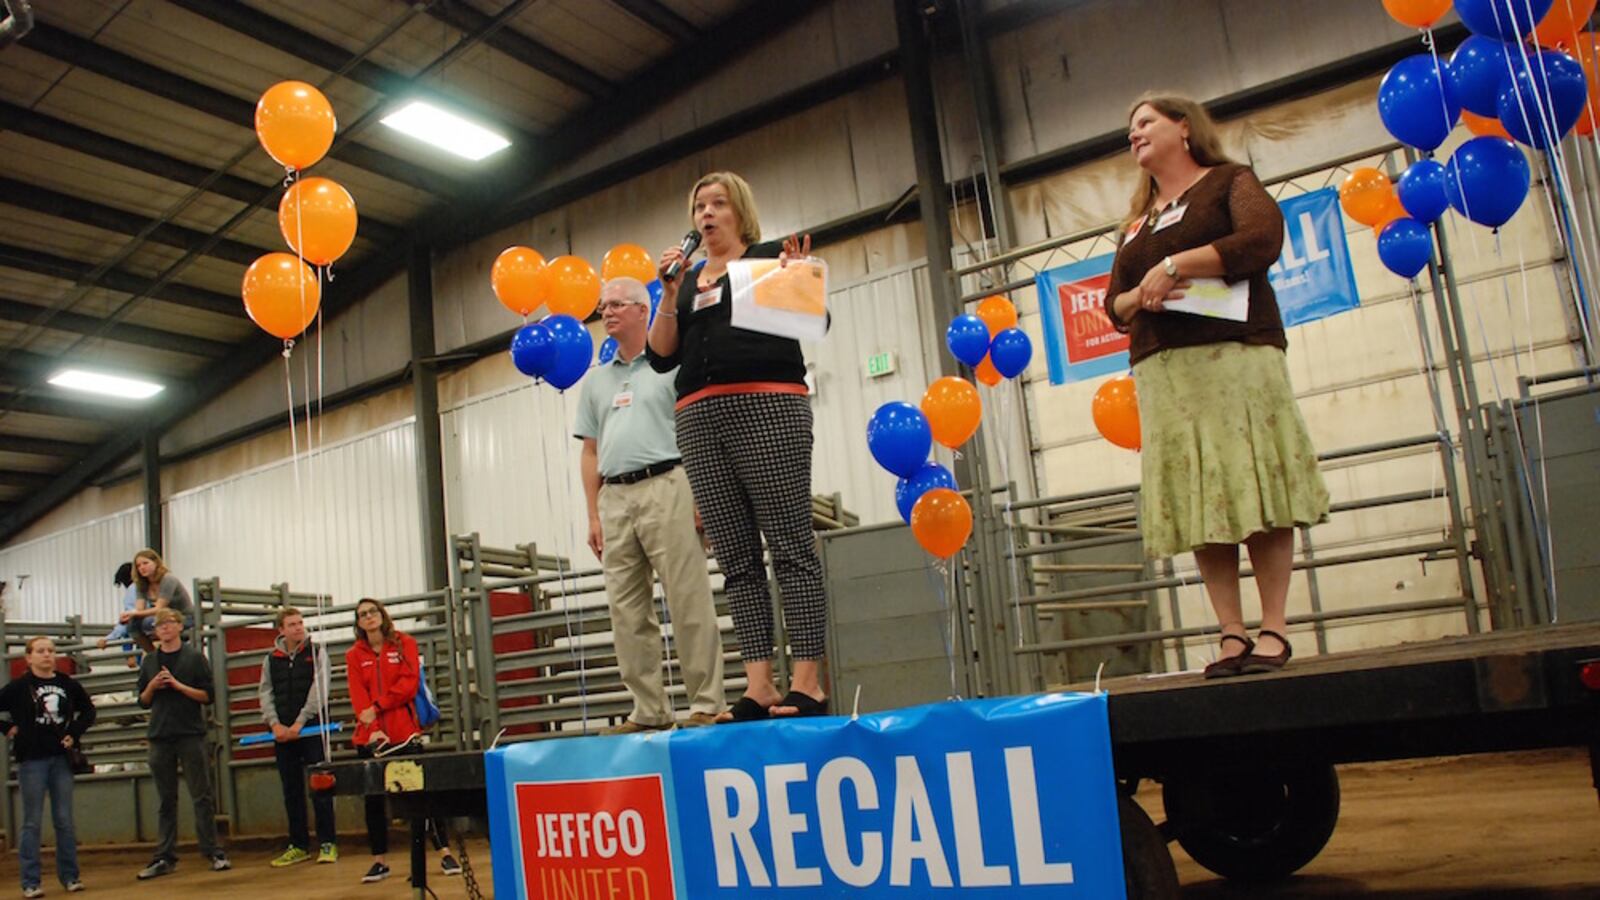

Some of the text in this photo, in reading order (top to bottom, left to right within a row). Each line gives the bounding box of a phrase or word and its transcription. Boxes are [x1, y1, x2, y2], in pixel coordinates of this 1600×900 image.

[1070, 288, 1107, 315] JEFF
[867, 353, 889, 374] EXIT
[535, 809, 646, 859] JEFFCO
[703, 746, 1074, 888] RECALL
[540, 866, 650, 900] UNITED
